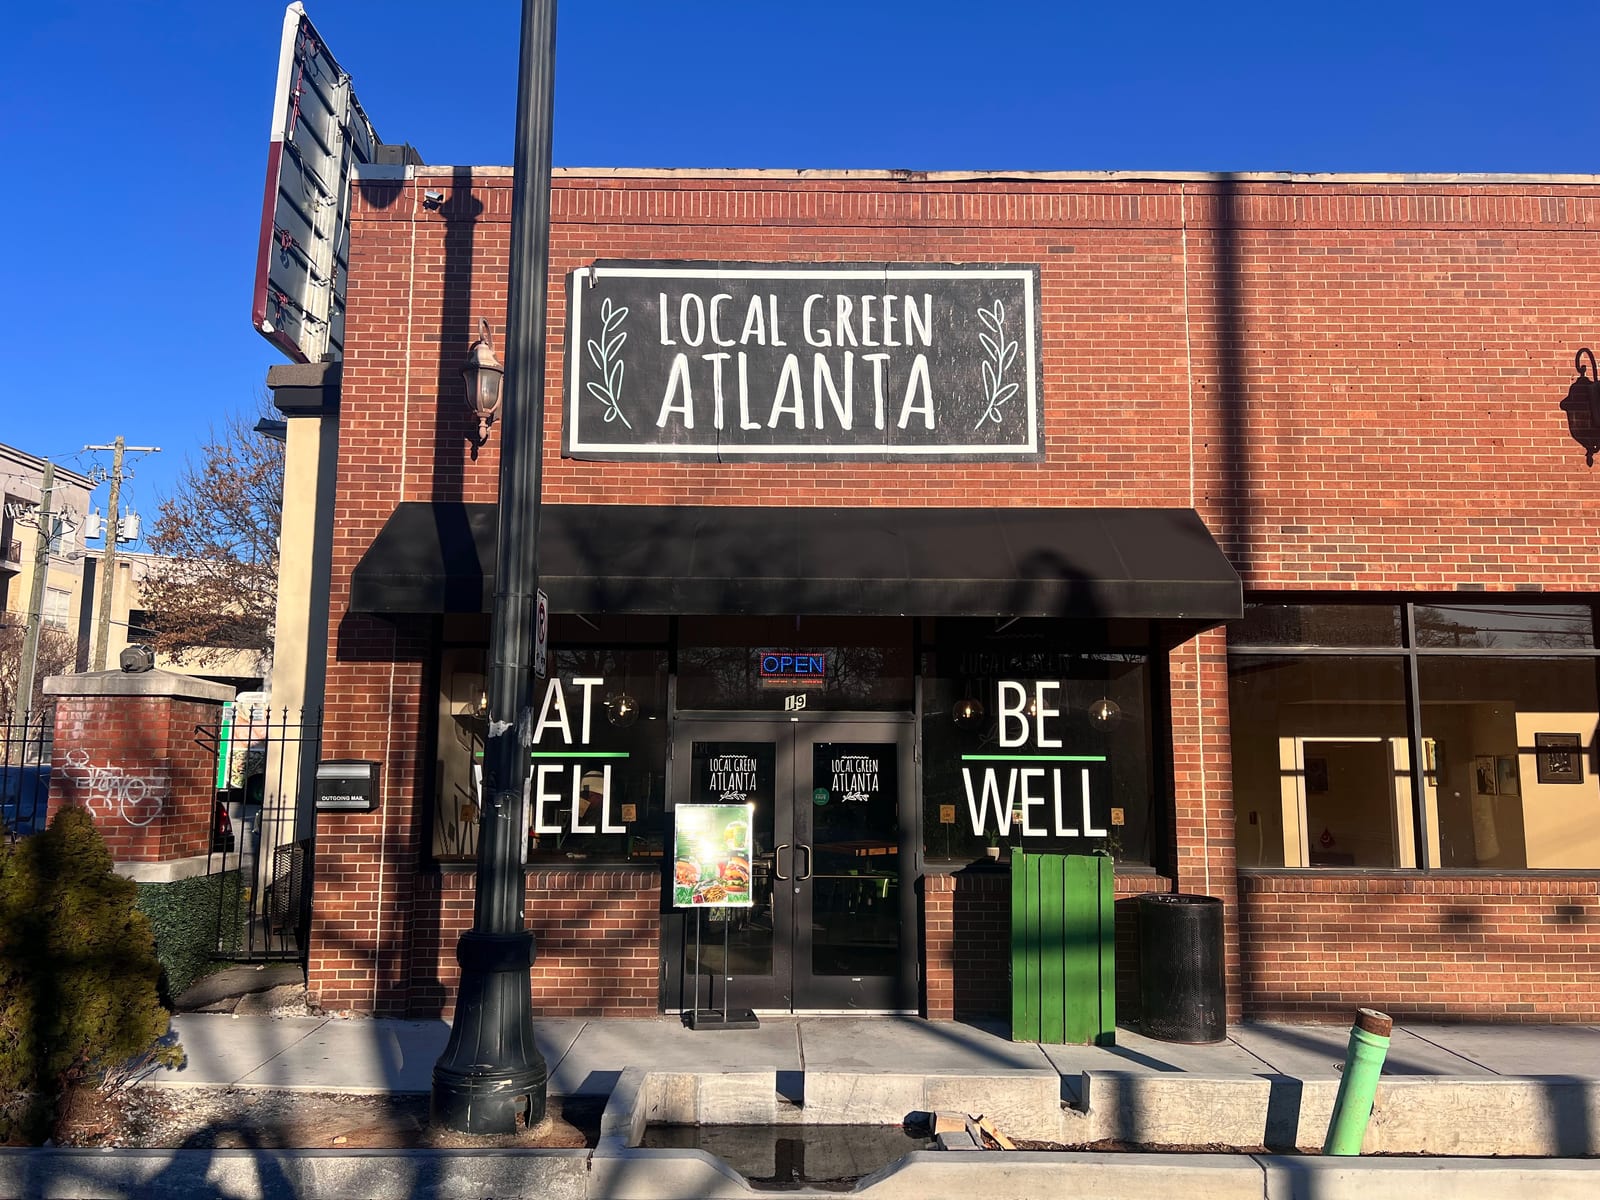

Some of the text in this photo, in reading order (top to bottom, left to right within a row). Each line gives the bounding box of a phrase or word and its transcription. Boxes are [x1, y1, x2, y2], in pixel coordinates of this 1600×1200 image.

[659, 292, 934, 348] LOCAL GREEN
[656, 350, 937, 432] ATLANTA
[763, 656, 823, 673] OPEN
[531, 677, 605, 745] AT
[998, 680, 1063, 748] BE
[709, 757, 757, 772] LOCAL GREEN
[709, 772, 757, 791] ATLANTA
[831, 758, 879, 773] LOCAL GREEN
[831, 773, 879, 792] ATLANTA
[961, 767, 1108, 838] WELL
